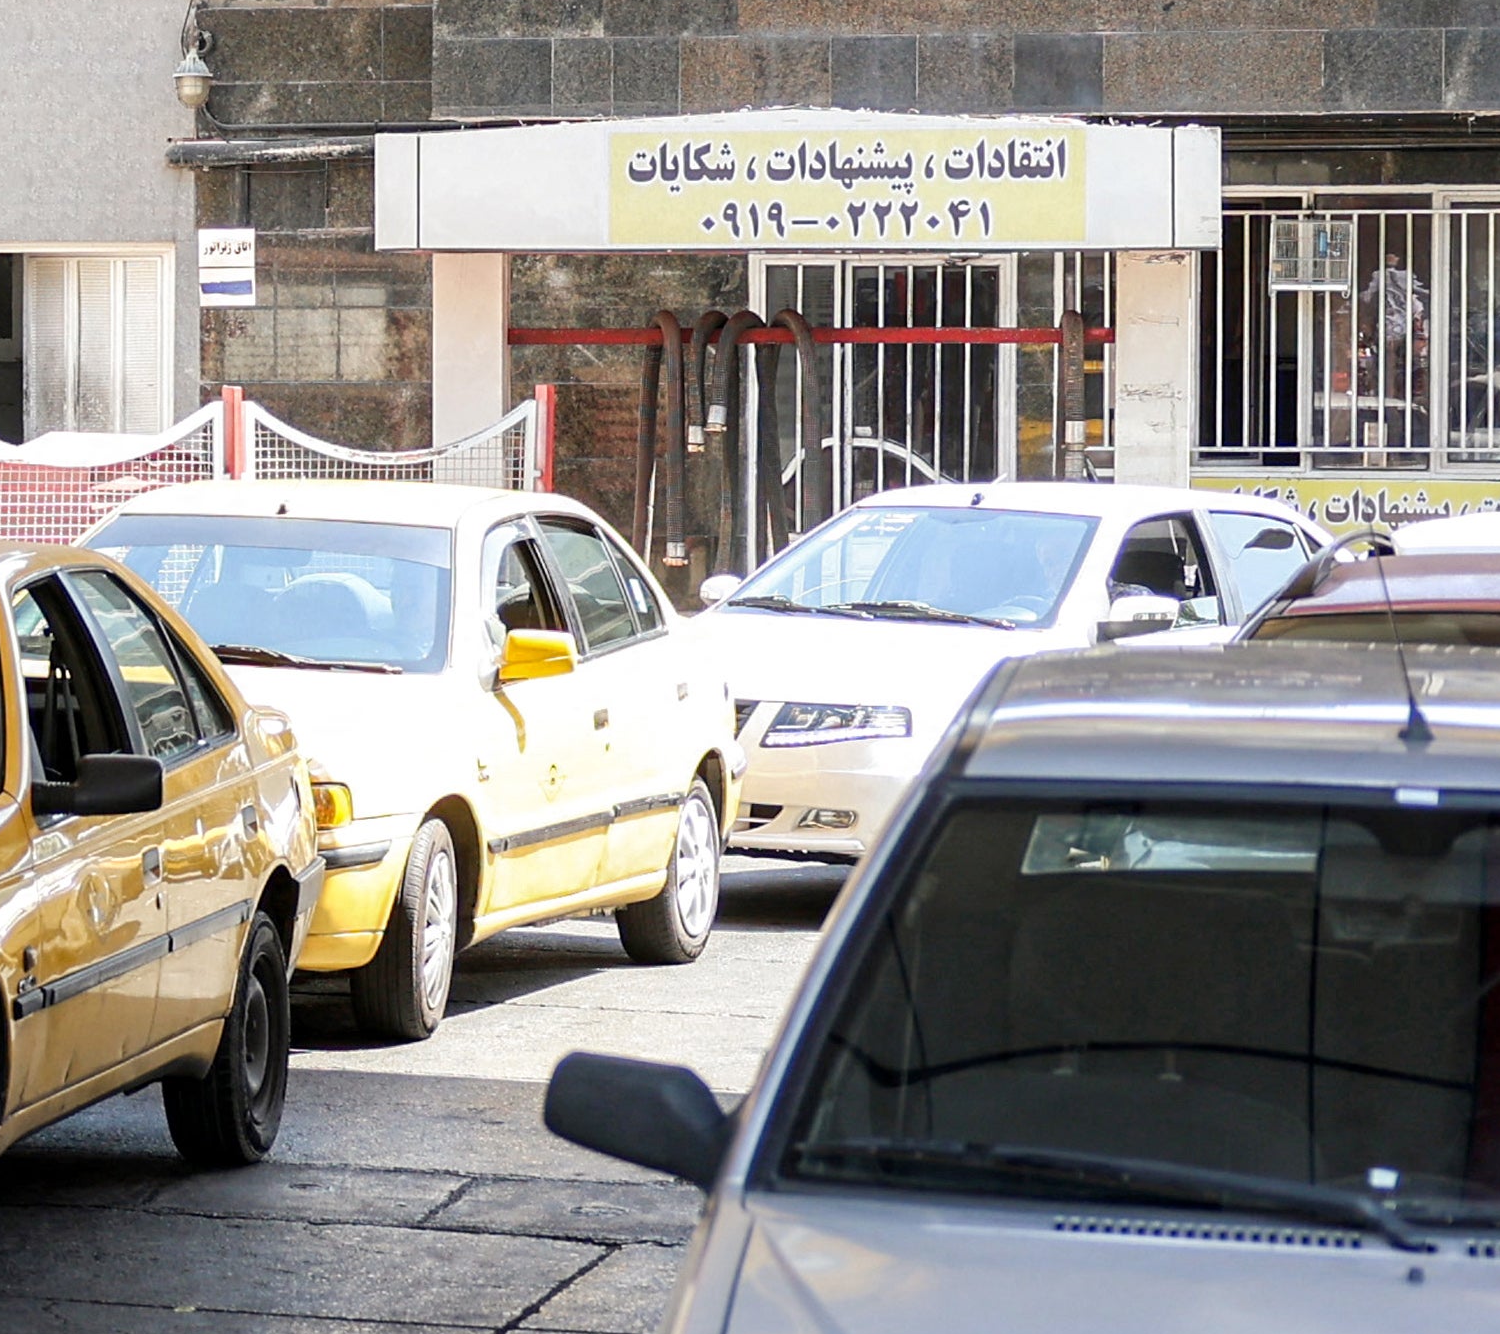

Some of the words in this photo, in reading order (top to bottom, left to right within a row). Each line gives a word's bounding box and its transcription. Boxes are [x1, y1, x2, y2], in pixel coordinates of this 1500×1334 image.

[628, 138, 736, 194] شکایات
[766, 140, 916, 194] پیشنهادات
[944, 138, 1068, 186] انتقادات
[700, 198, 994, 240] ۰۹۱۹-۰۲۲۲۰۴۱
[203, 241, 232, 255] ژنراتور
[234, 241, 251, 255] اتاق
